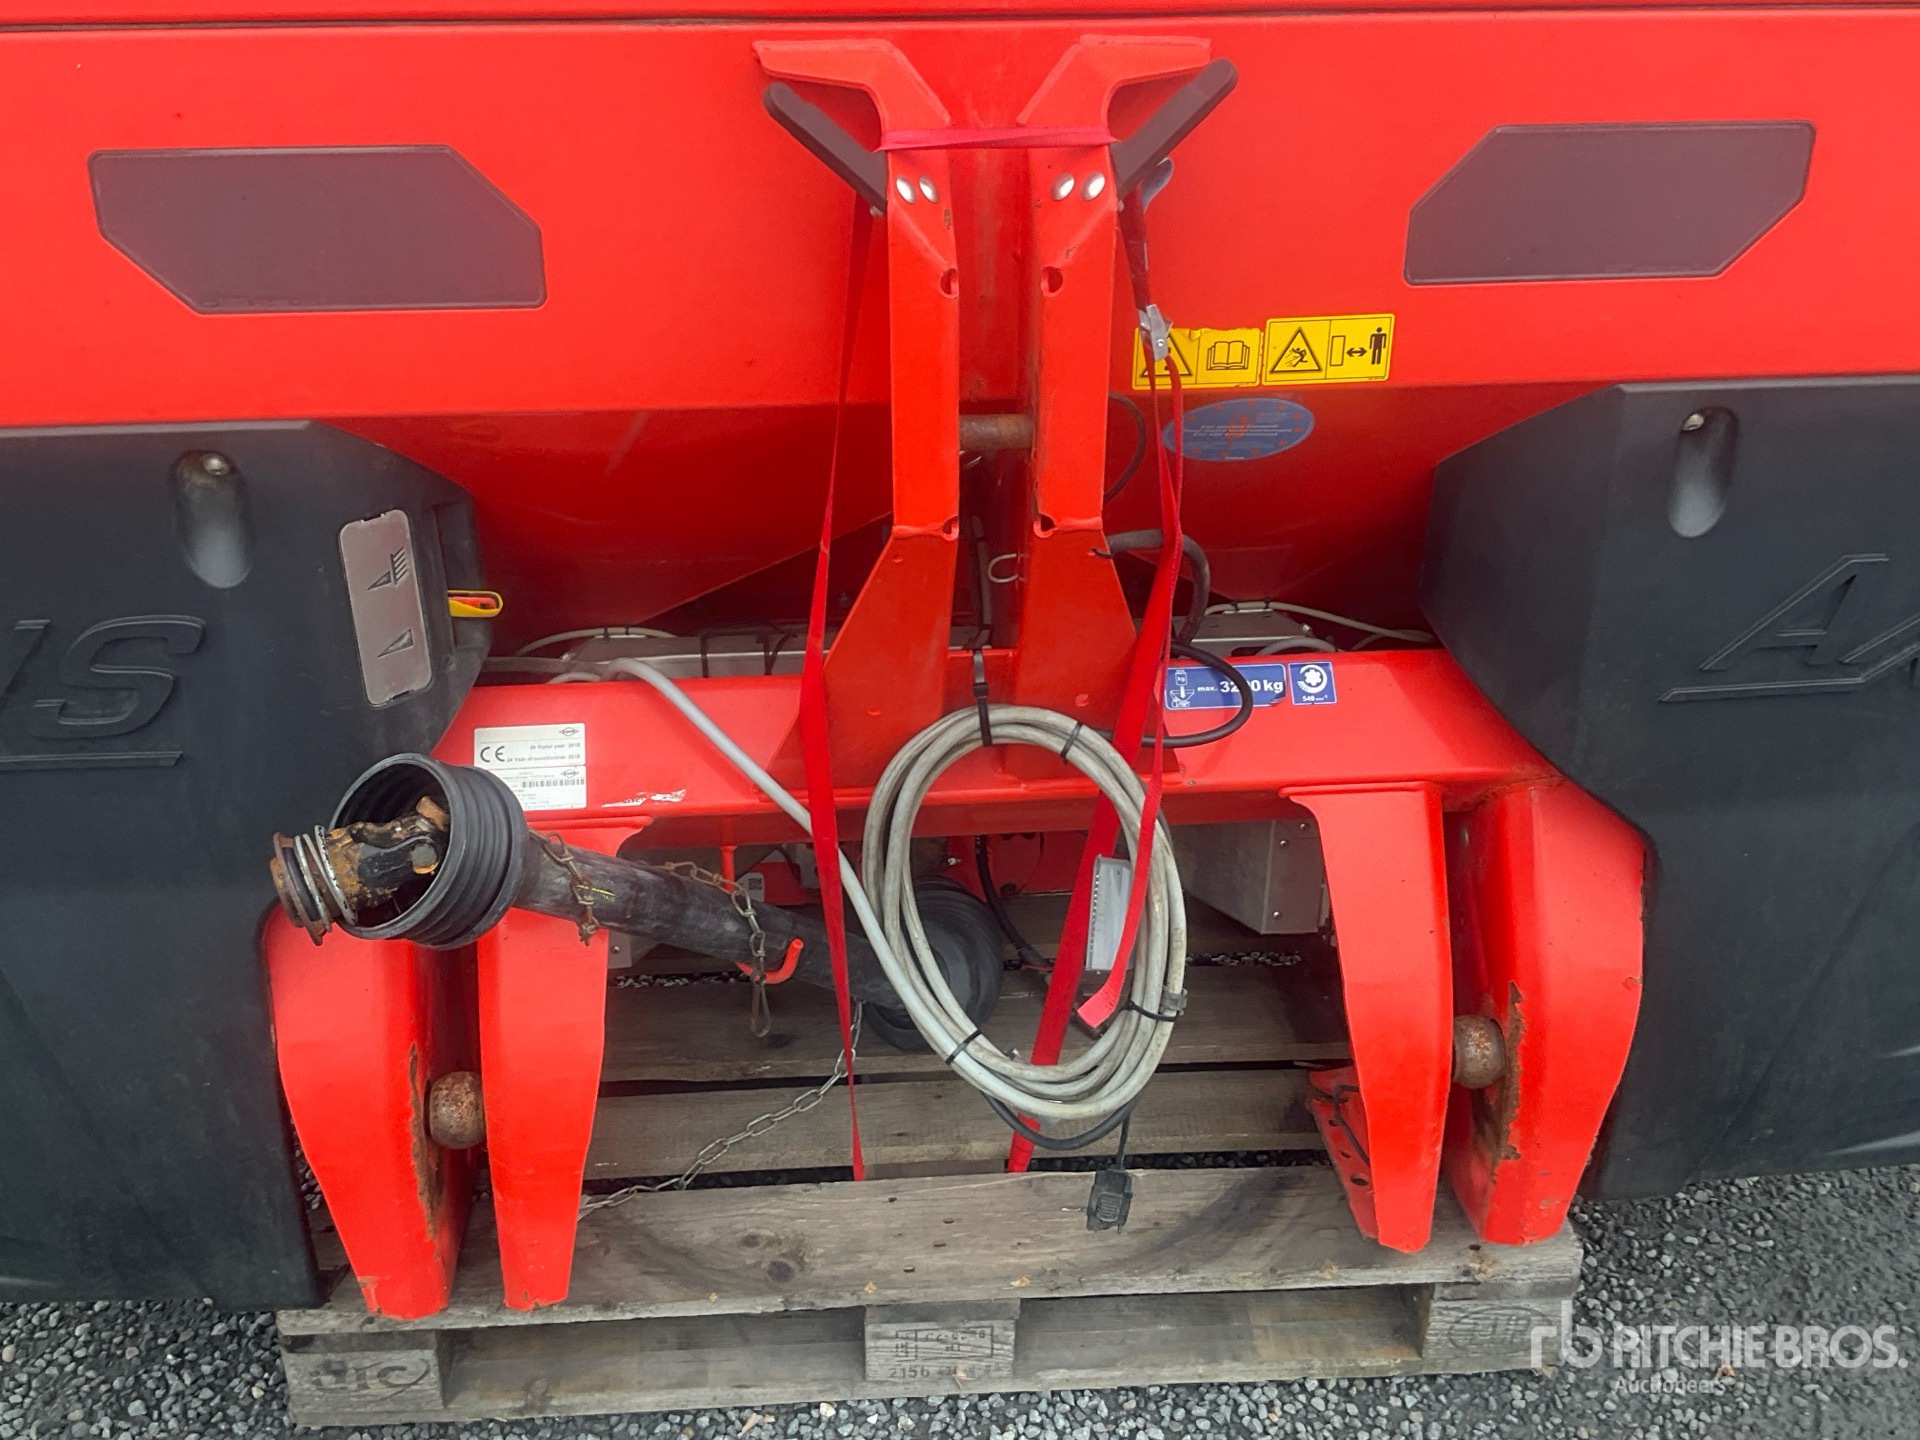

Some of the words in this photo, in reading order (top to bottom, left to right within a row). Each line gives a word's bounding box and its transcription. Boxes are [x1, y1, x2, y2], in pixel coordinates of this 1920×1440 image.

[1219, 679, 1261, 693] 320
[1263, 679, 1284, 694] kg
[480, 745, 505, 763] CE
